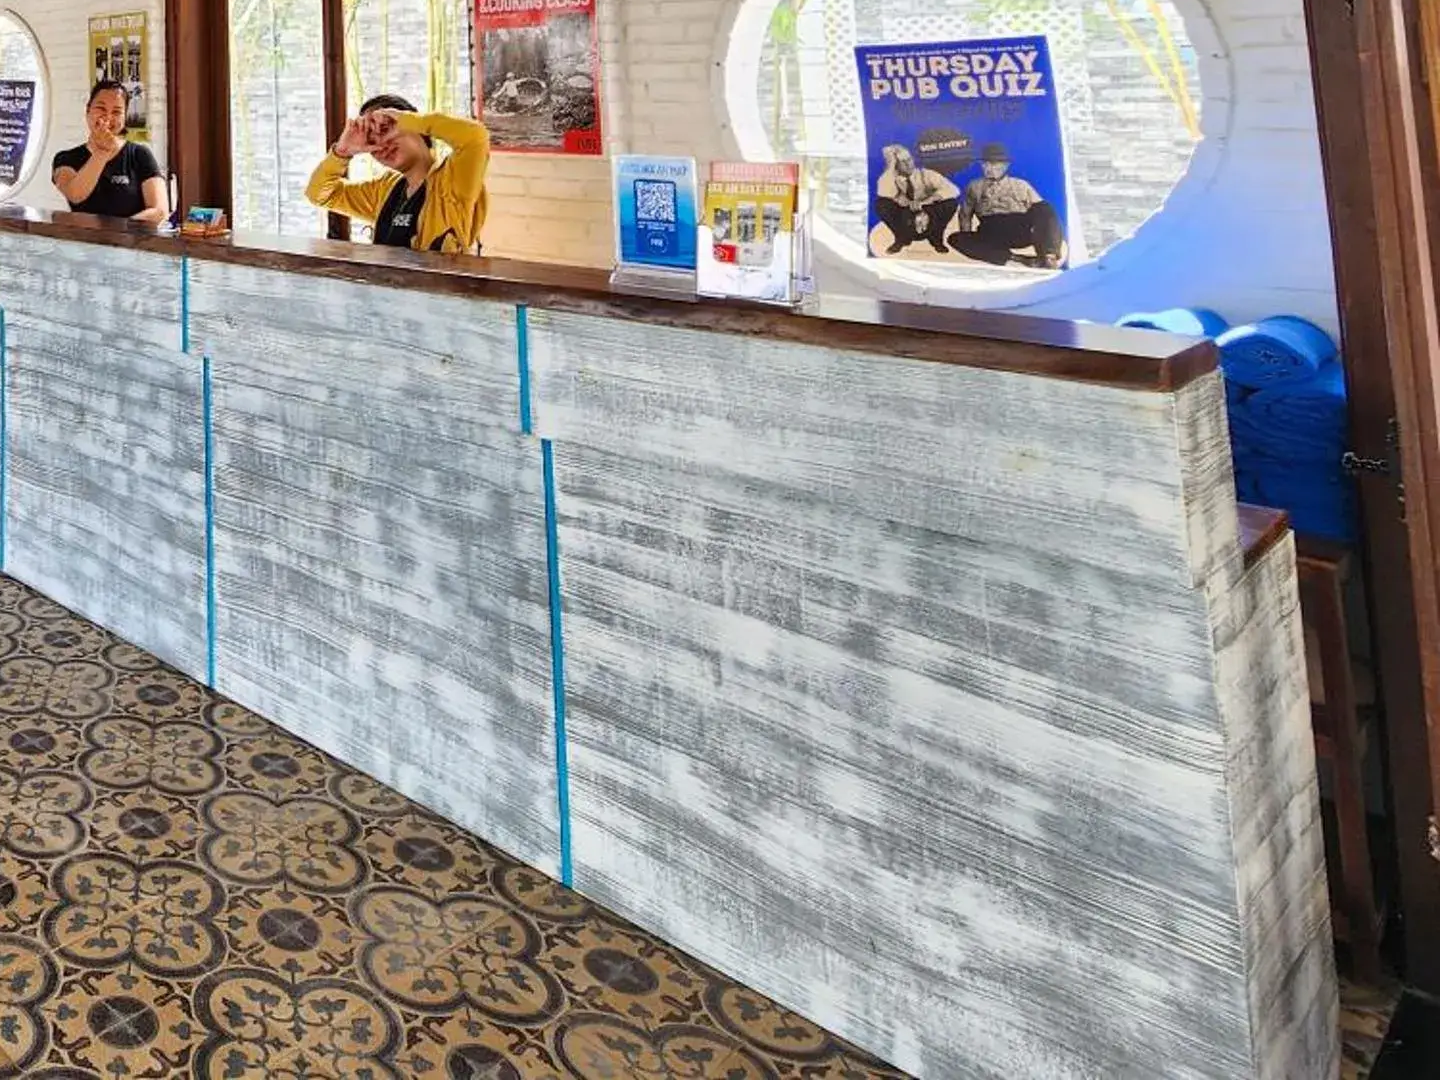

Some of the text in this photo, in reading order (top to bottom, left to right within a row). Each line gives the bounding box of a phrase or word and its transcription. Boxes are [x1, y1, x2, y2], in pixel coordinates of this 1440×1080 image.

[866, 50, 1039, 78] THURSDAY
[871, 72, 1047, 100] PUB QUIZ
[938, 138, 969, 151] ENTRY
